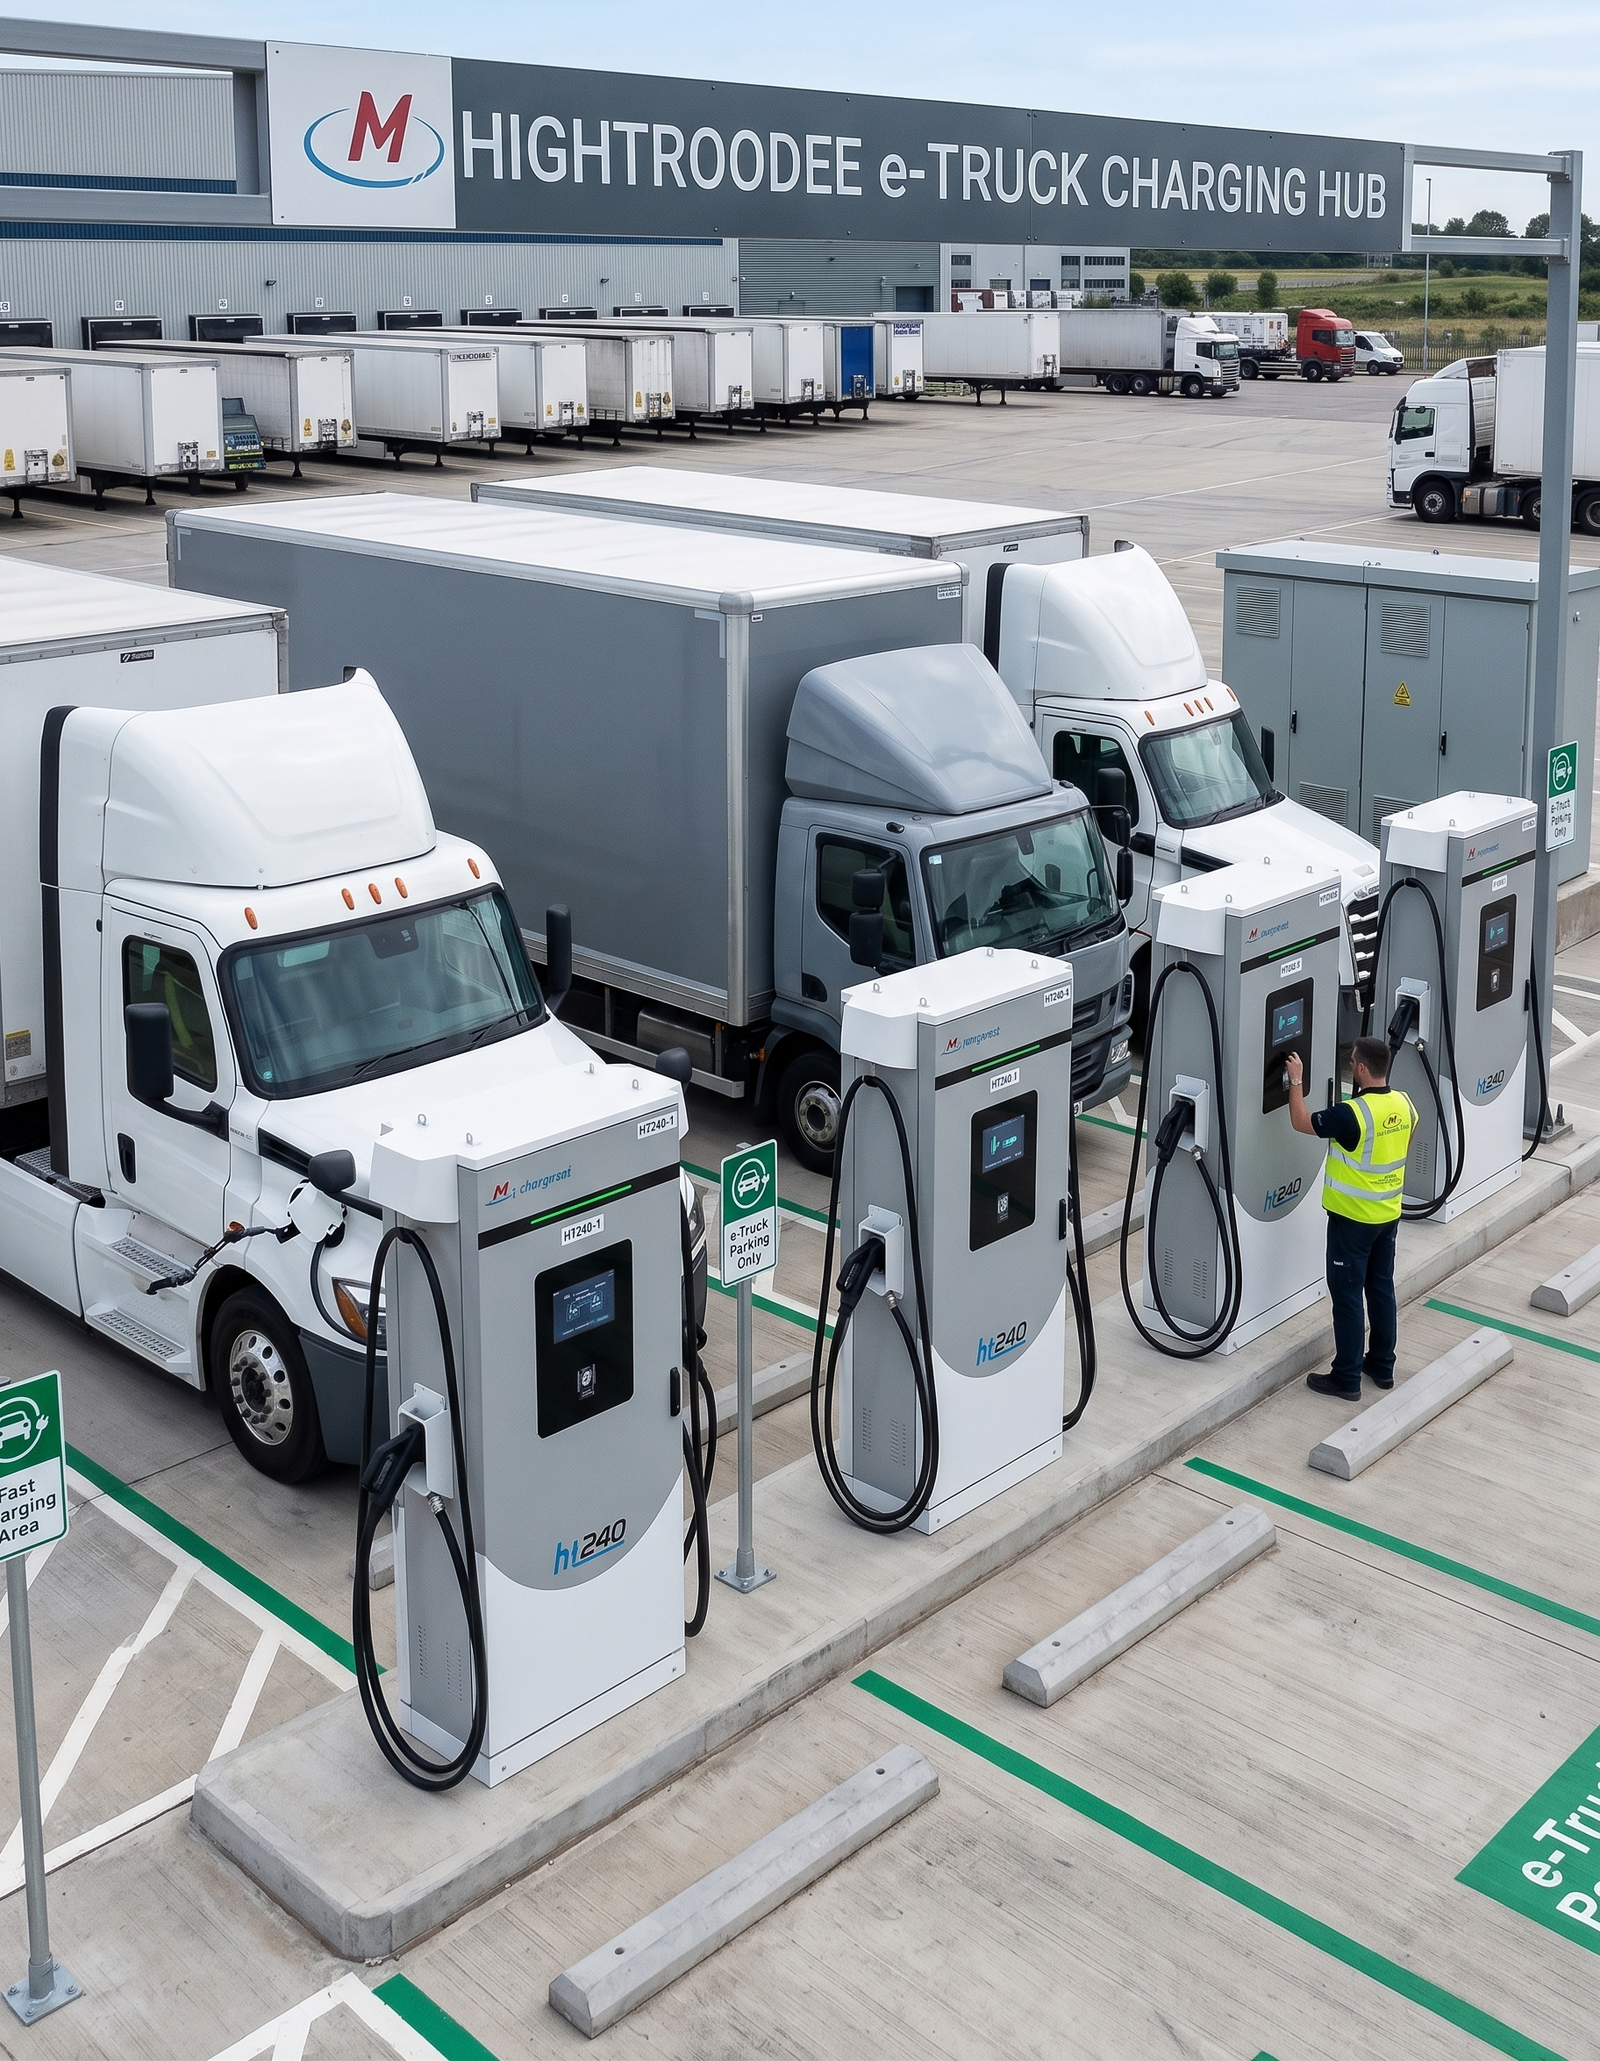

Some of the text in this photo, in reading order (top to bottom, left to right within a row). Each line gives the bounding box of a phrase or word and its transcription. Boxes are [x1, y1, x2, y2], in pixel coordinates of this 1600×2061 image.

[347, 90, 414, 163] M
[461, 109, 1387, 220] HIGHTROODEE e-TRUCK CHARGING HUB
[492, 1180, 510, 1201] M
[730, 1217, 769, 1241] e-Truck
[730, 1234, 770, 1258] Parking
[737, 1252, 762, 1269] Only
[976, 1320, 1027, 1366] ht240
[0, 1478, 36, 1504] Fast
[0, 1493, 56, 1523] arging
[0, 1520, 40, 1544] Area
[1521, 1761, 1600, 1888] e-Tru
